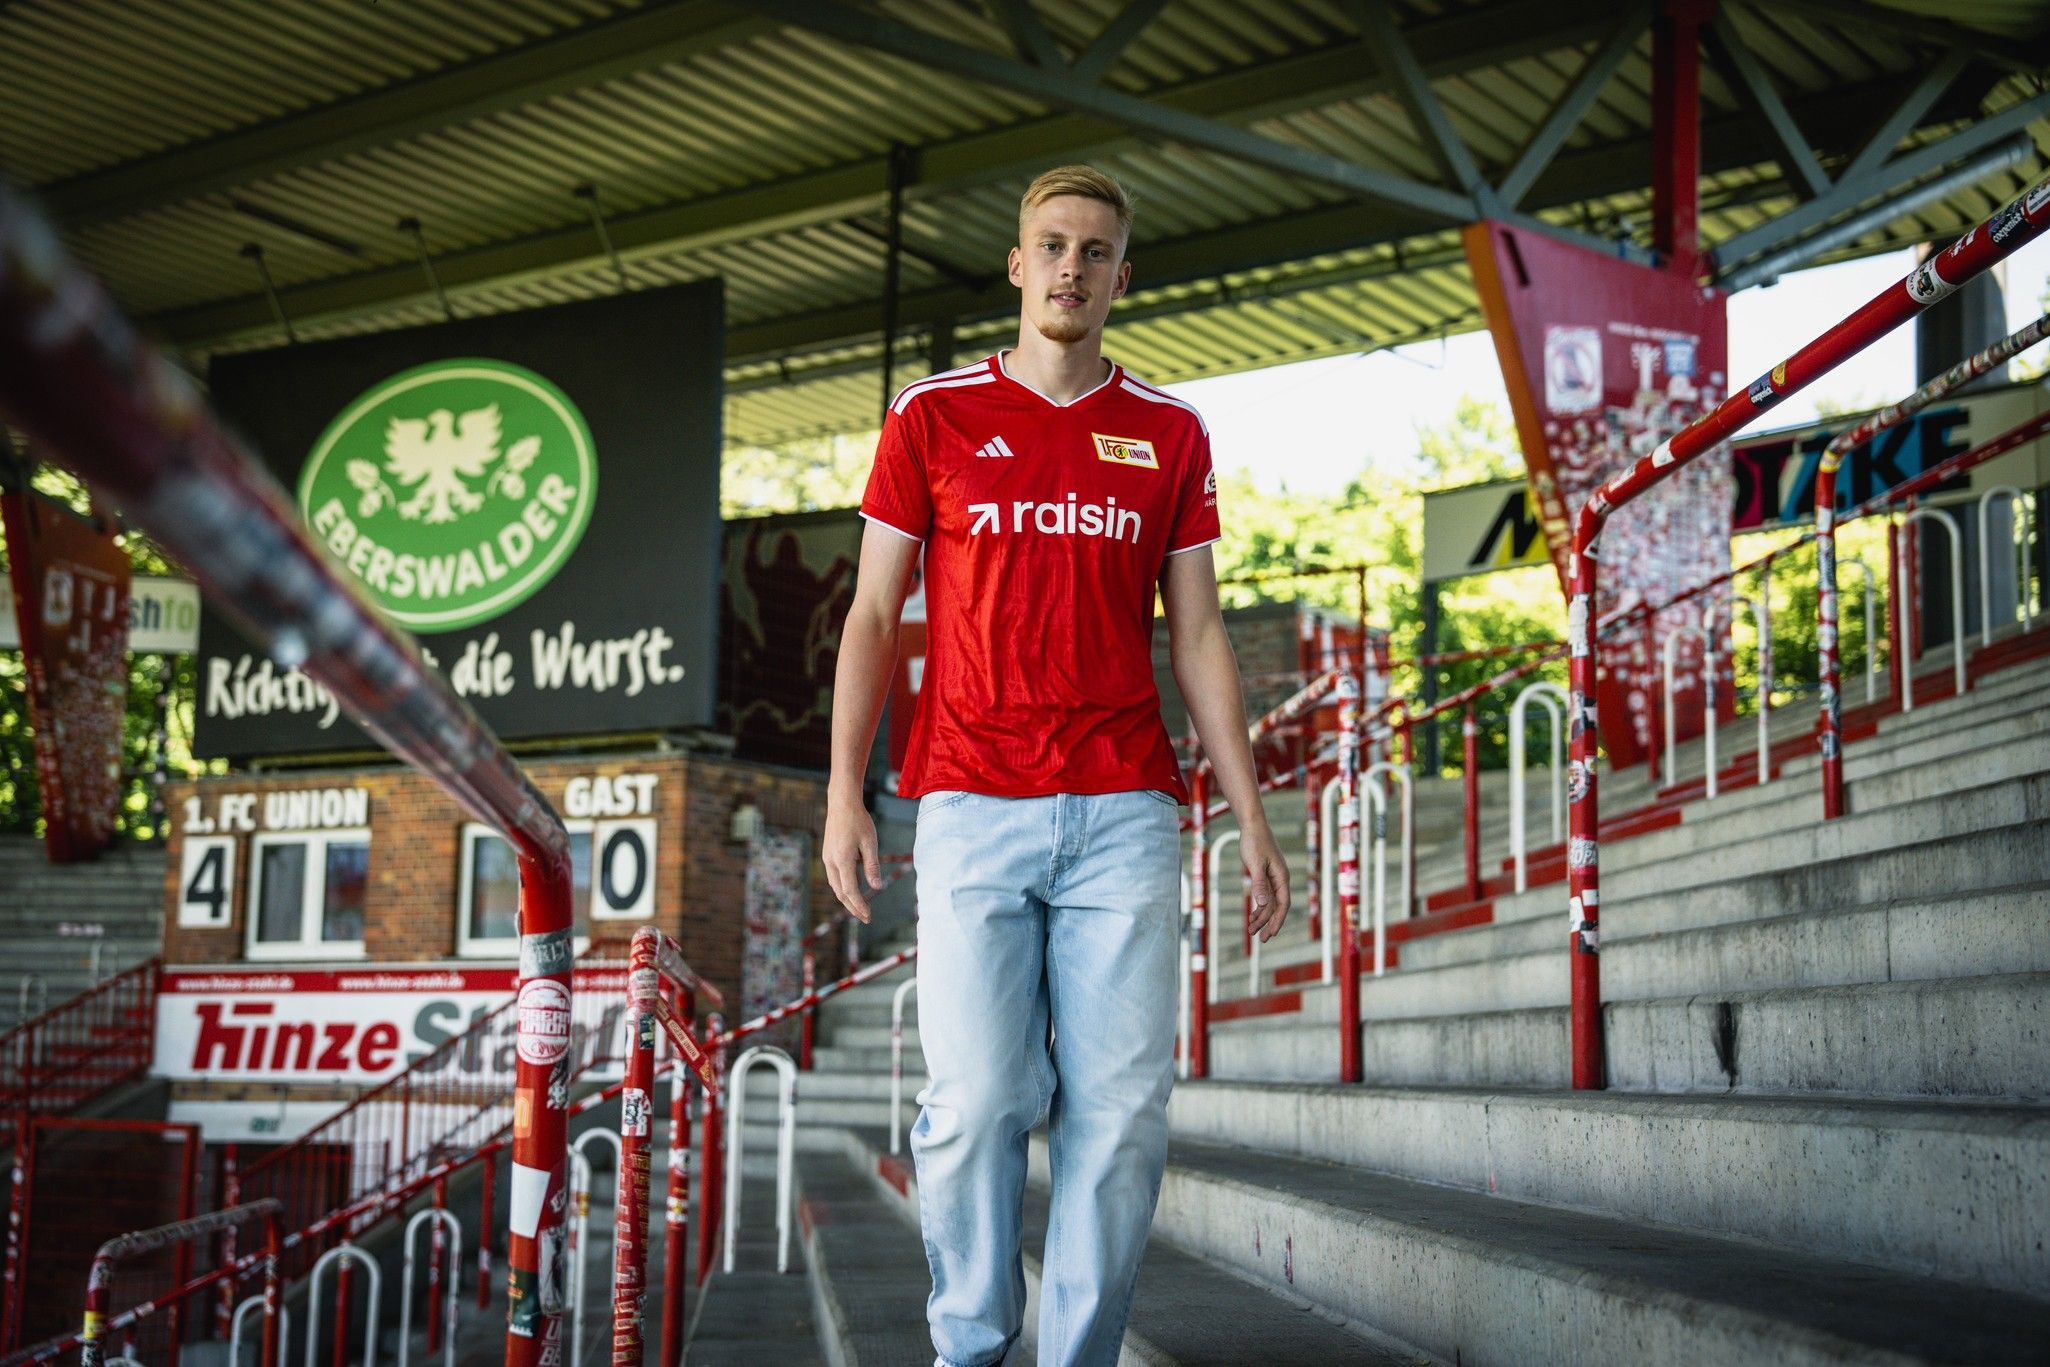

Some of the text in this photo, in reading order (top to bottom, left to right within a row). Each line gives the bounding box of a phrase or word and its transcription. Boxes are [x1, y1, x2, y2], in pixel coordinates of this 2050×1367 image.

[1128, 448, 1151, 461] UNION
[313, 473, 577, 600] EBERSWALDER
[1013, 492, 1142, 544] raisin
[452, 620, 685, 697] die Wurst.
[183, 787, 369, 833] 1. FC UNION
[564, 774, 659, 817] GAST
[186, 845, 226, 919] 4
[601, 829, 647, 911] 0
